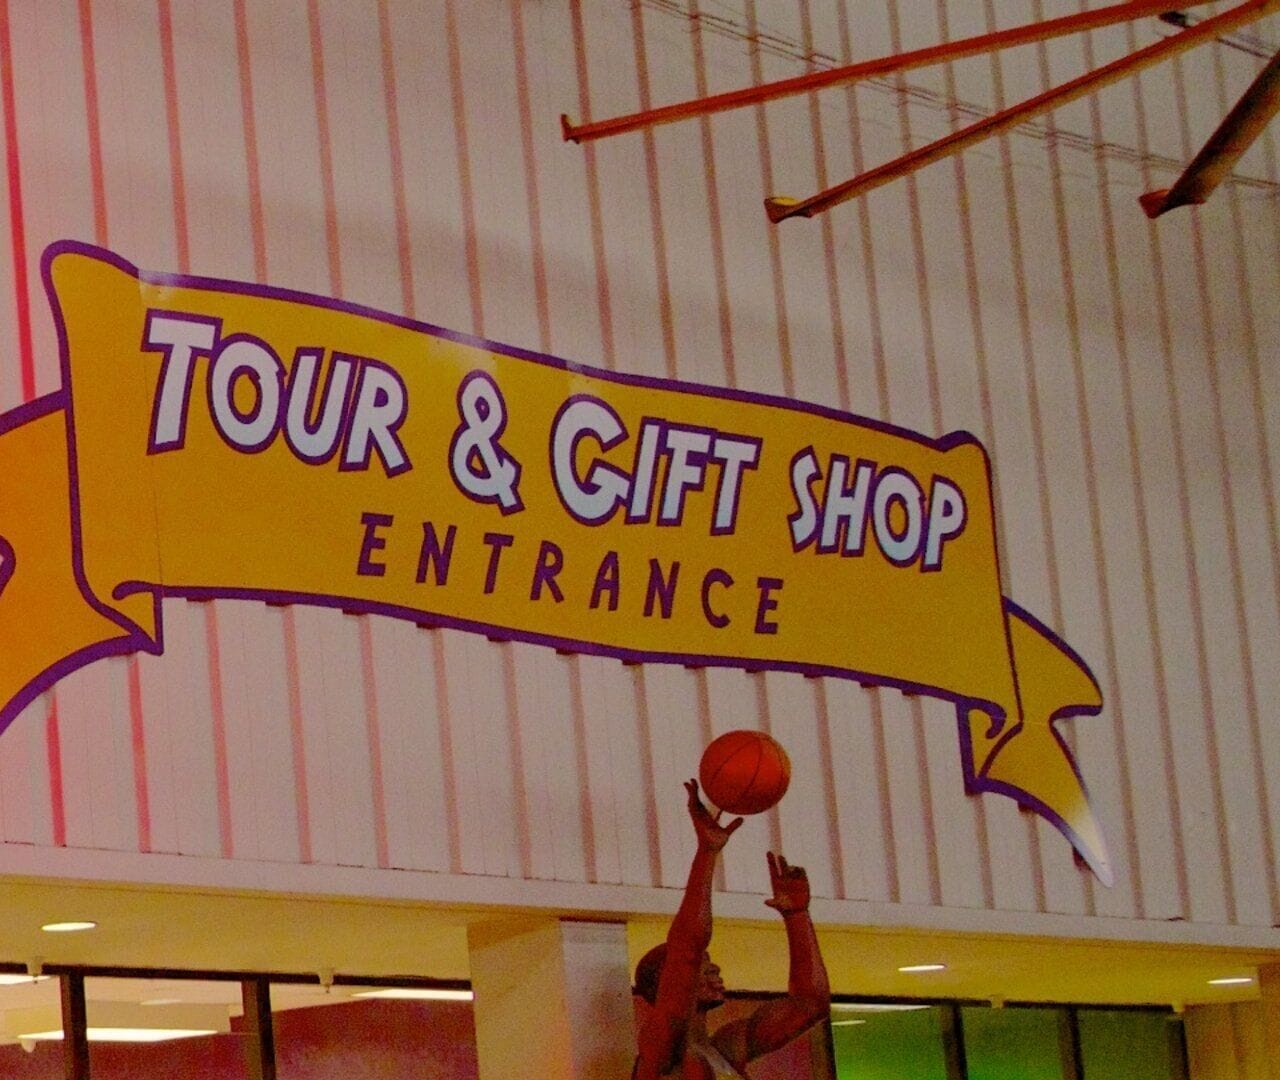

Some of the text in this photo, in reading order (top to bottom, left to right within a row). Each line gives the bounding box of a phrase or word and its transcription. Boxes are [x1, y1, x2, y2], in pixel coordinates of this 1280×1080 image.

[142, 307, 968, 572] TOUR & GIFT SHOP
[356, 512, 784, 635] ENTRANCE
